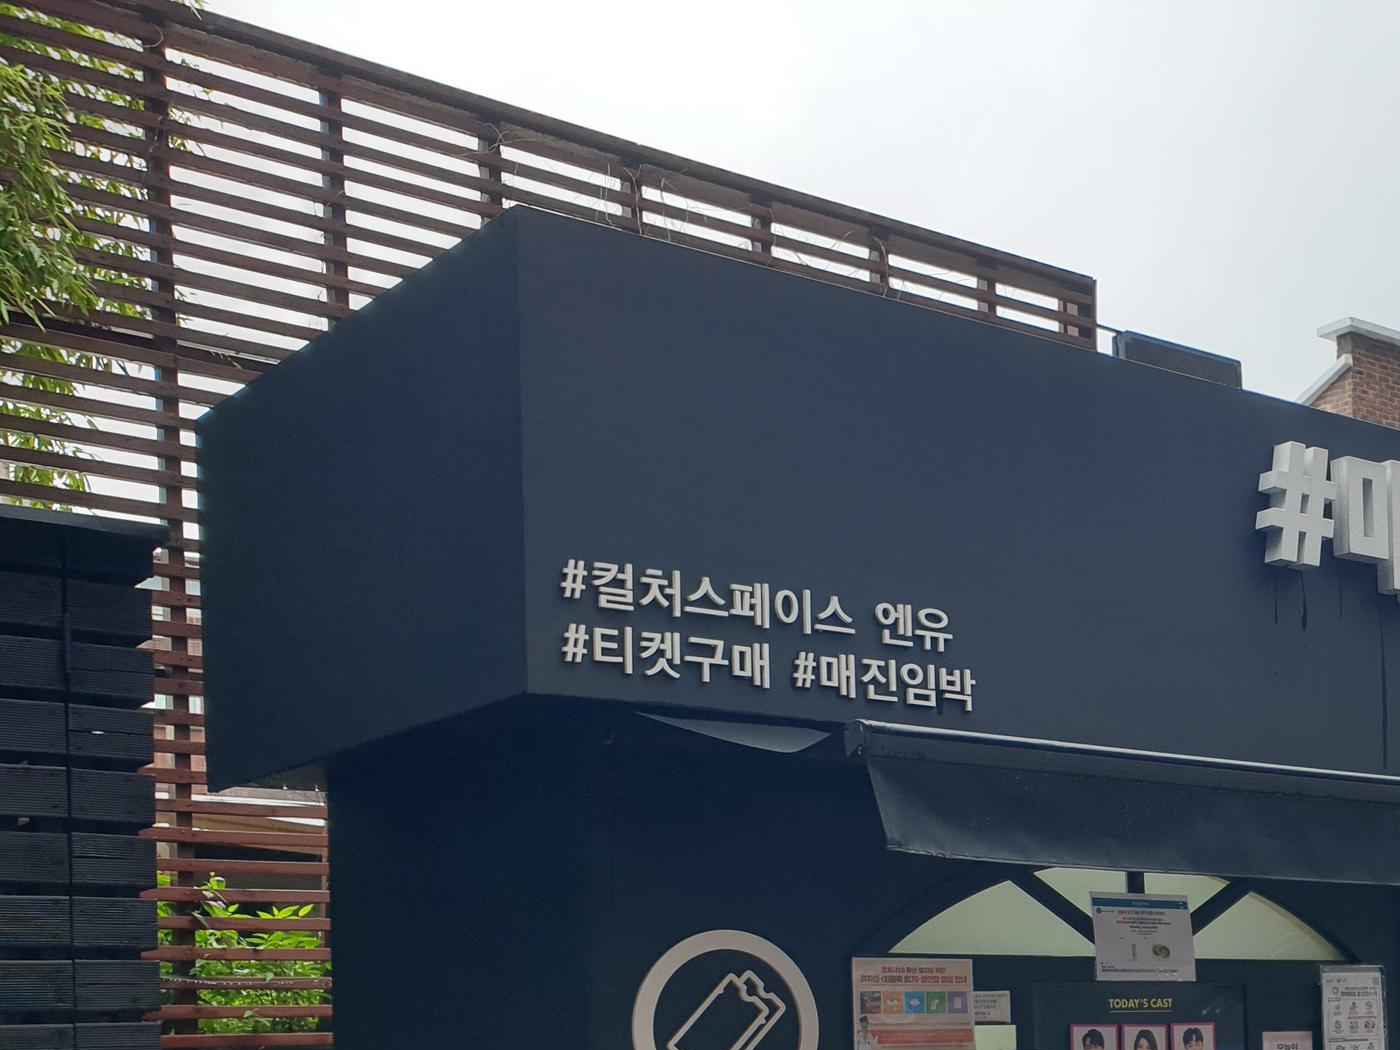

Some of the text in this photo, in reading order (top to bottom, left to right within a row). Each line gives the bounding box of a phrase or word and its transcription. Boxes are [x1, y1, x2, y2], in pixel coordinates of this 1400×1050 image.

[560, 559, 954, 652] #컬처스페이스 엔유
[561, 623, 976, 712] #티켓구매 #매진임박
[1109, 998, 1172, 1009] TODAY'S CAST
